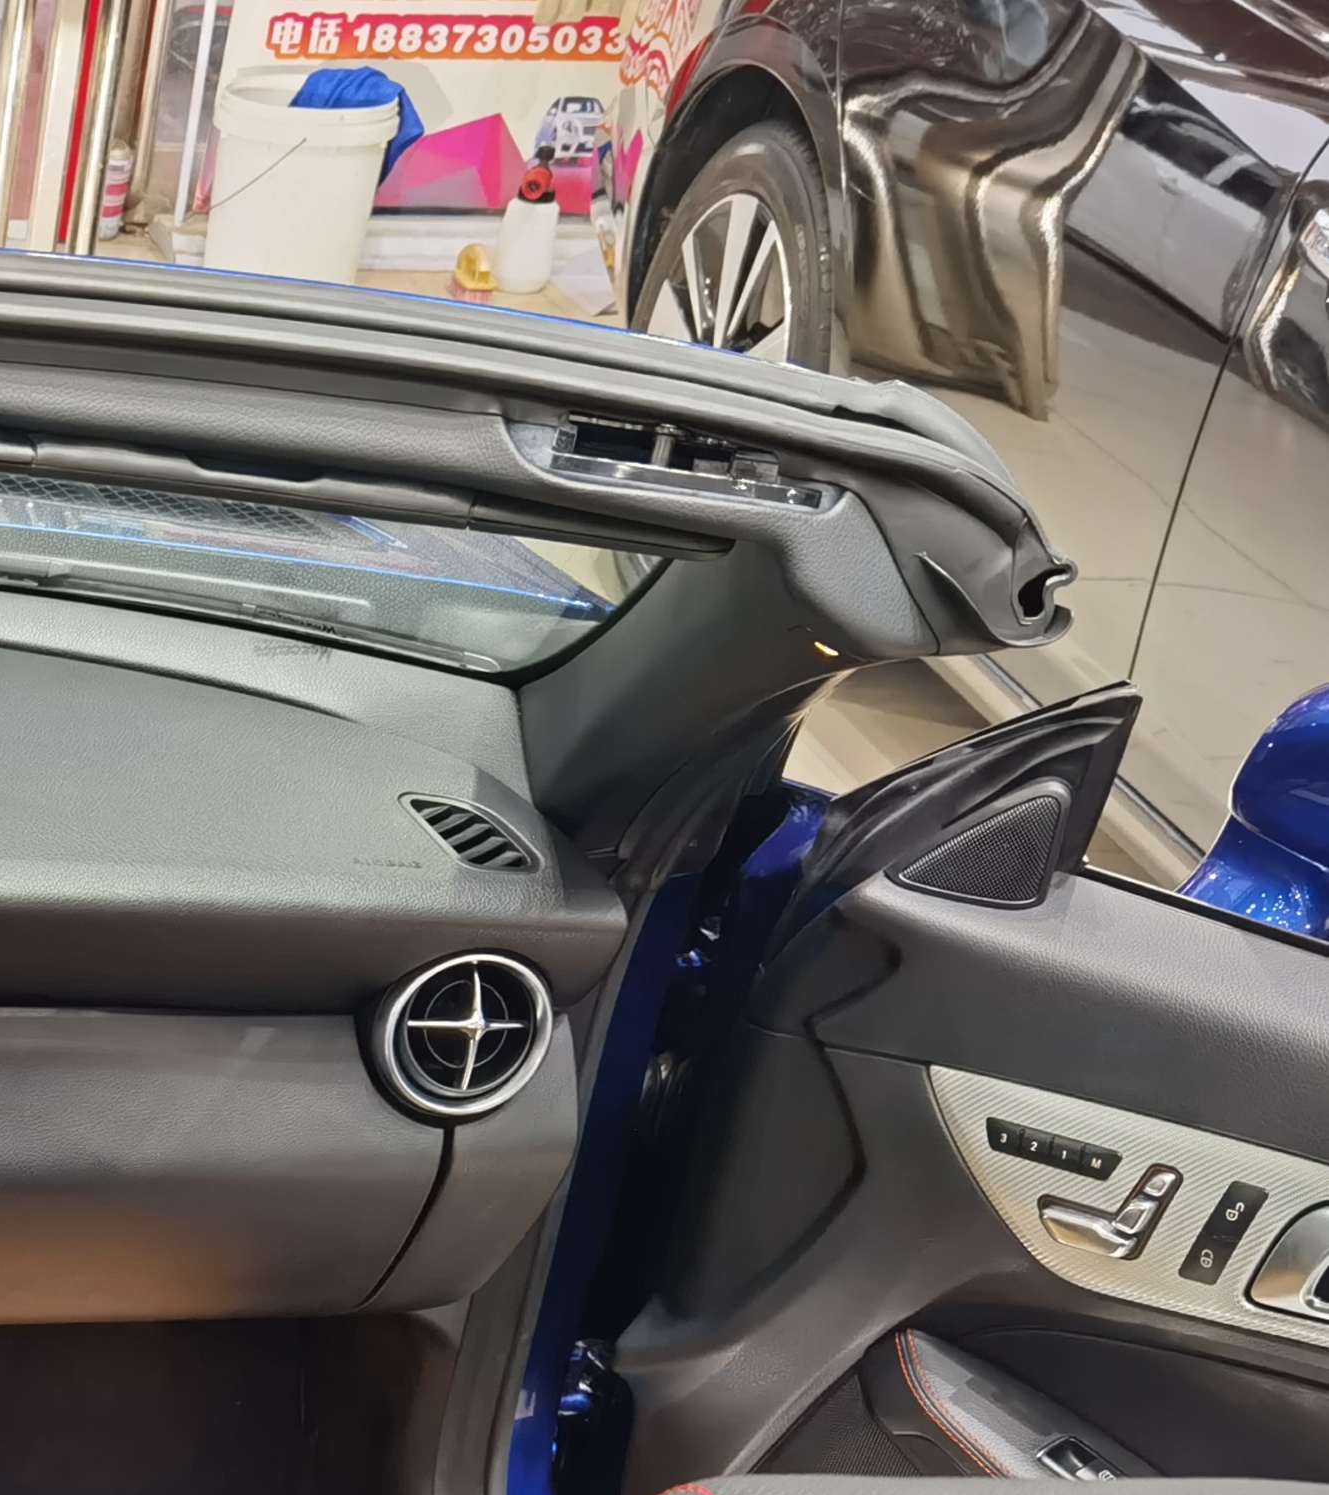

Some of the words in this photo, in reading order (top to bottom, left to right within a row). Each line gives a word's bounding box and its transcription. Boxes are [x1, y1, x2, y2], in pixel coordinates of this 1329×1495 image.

[270, 16, 342, 55] 电话
[352, 23, 627, 55] 18837305033
[1000, 1133, 1008, 1144] 3
[1029, 1141, 1038, 1152] 2
[1061, 1150, 1068, 1160] 1
[1090, 1157, 1102, 1170] M
